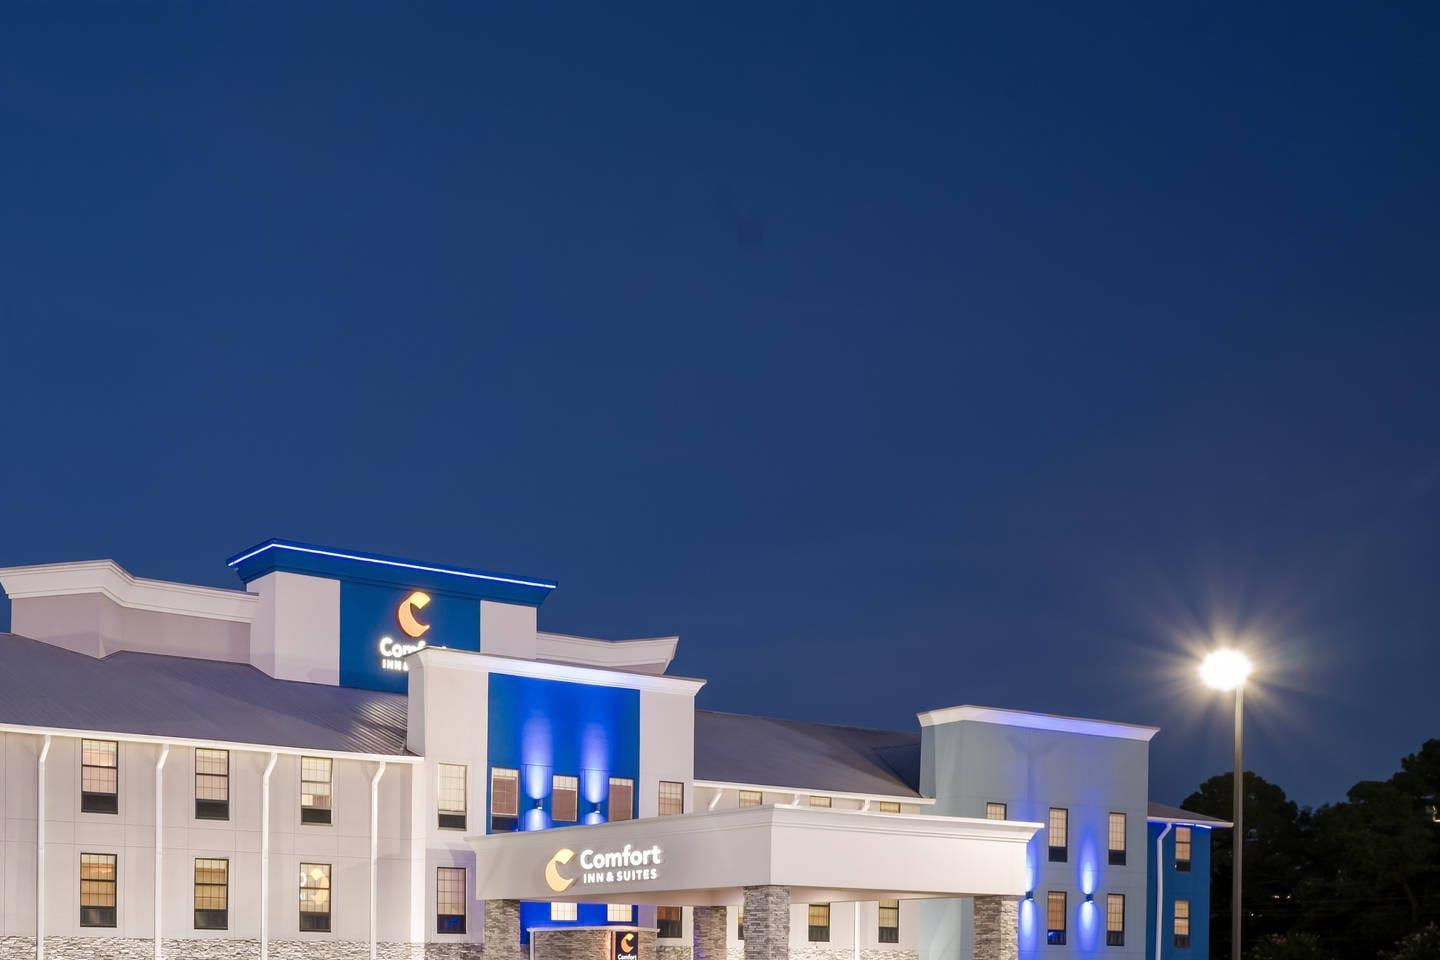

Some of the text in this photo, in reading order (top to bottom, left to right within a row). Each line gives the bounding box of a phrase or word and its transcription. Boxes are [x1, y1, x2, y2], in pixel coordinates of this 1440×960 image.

[381, 659, 402, 671] INN
[580, 844, 661, 870] Comfort
[583, 868, 657, 884] INN & SUITES
